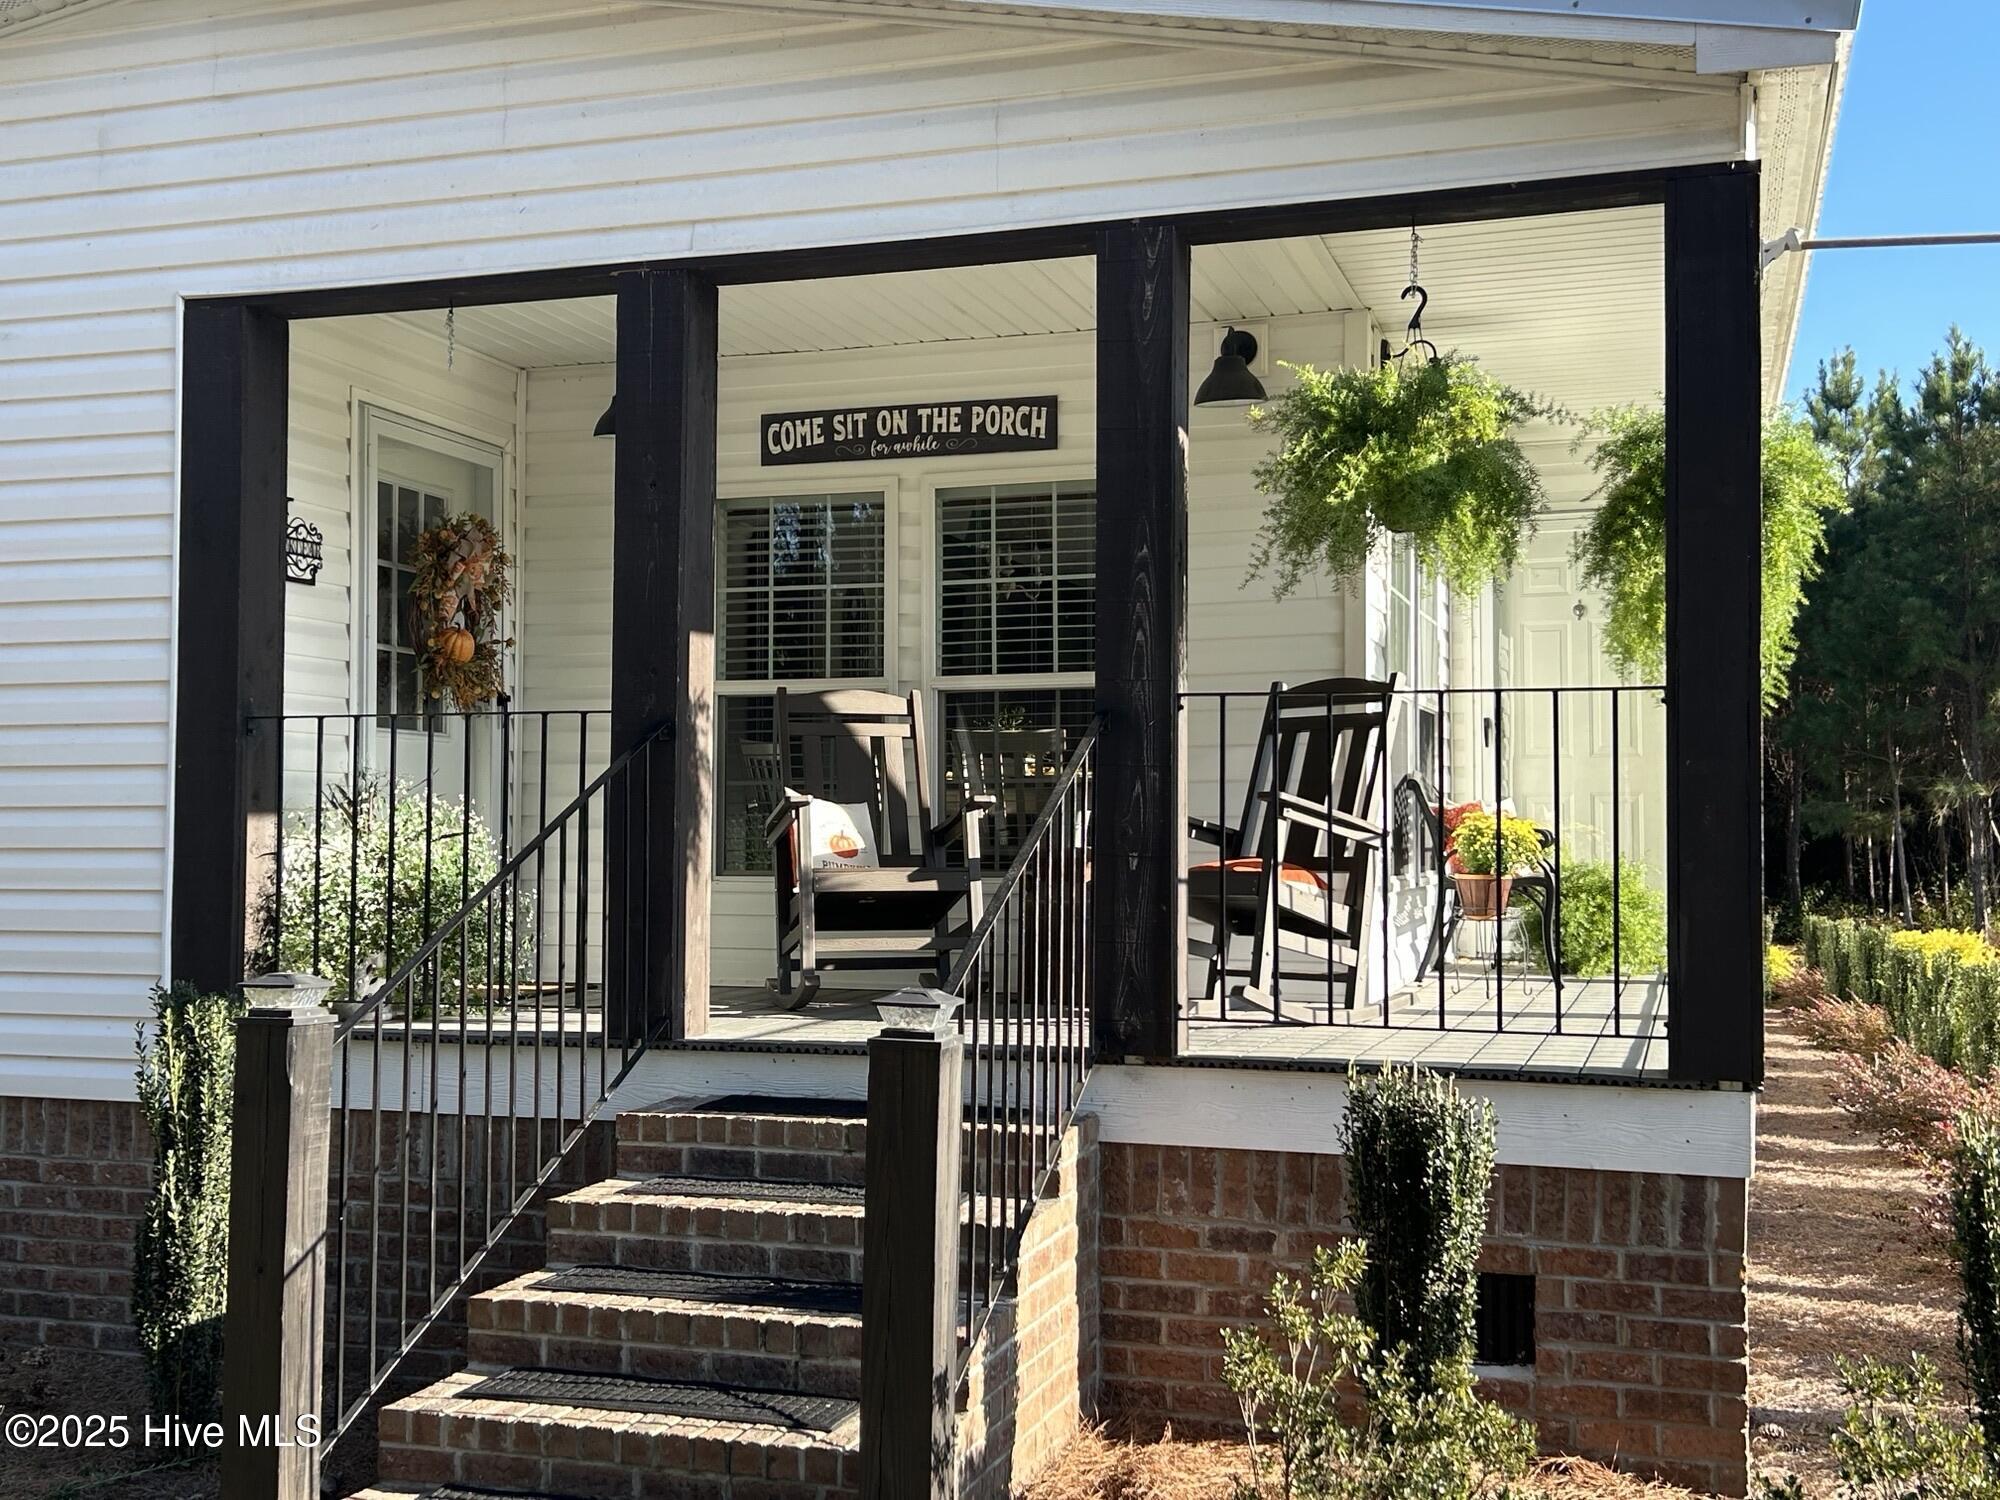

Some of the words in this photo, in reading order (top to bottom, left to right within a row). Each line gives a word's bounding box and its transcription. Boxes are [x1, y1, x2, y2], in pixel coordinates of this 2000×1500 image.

[768, 417, 824, 455] COME
[833, 412, 867, 441] SIT
[876, 409, 908, 437] ON
[917, 406, 962, 433] THE
[970, 405, 1048, 439] PORCH
[870, 439, 892, 458] for
[893, 435, 941, 454] awhile
